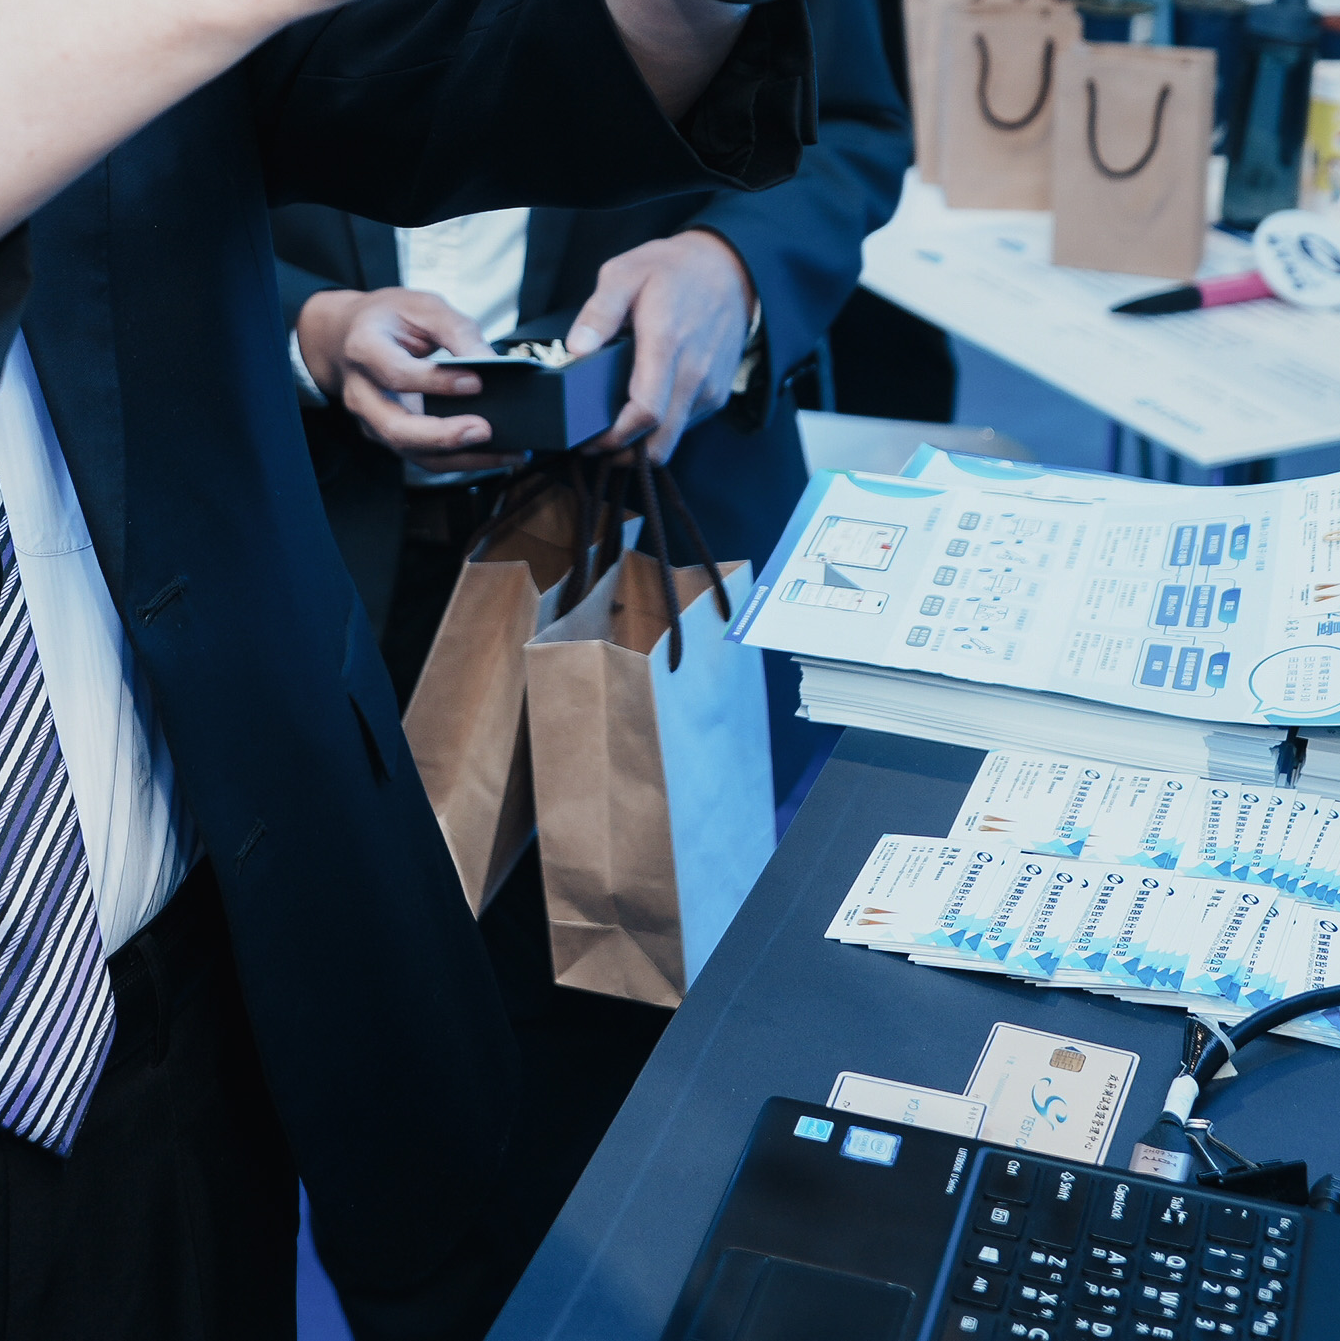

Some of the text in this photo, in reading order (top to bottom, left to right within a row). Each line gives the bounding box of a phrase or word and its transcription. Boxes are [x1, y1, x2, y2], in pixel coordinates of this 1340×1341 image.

[1311, 933, 1332, 989] 關貿網路股份有限
[907, 1098, 921, 1111] CA
[1084, 1073, 1120, 1150] 政府測試憑證管理中心
[1019, 1115, 1037, 1138] TEST
[1006, 1160, 1021, 1177] Ctrl
[1056, 1181, 1073, 1201] Shift
[1110, 1183, 1130, 1221] Caps Lock
[1170, 1196, 1185, 1211] Tab
[1106, 1250, 1127, 1265] A
[1208, 1247, 1229, 1257] 1
[1047, 1255, 1068, 1270] Z
[1165, 1255, 1187, 1270] Q
[971, 1275, 989, 1293] Alt
[1099, 1285, 1121, 1298] S
[1201, 1280, 1222, 1294] 2
[1037, 1290, 1059, 1307] X
[1159, 1291, 1181, 1309] W
[1091, 1322, 1113, 1338] D
[1194, 1317, 1216, 1331] 3
[1152, 1326, 1174, 1341] E
